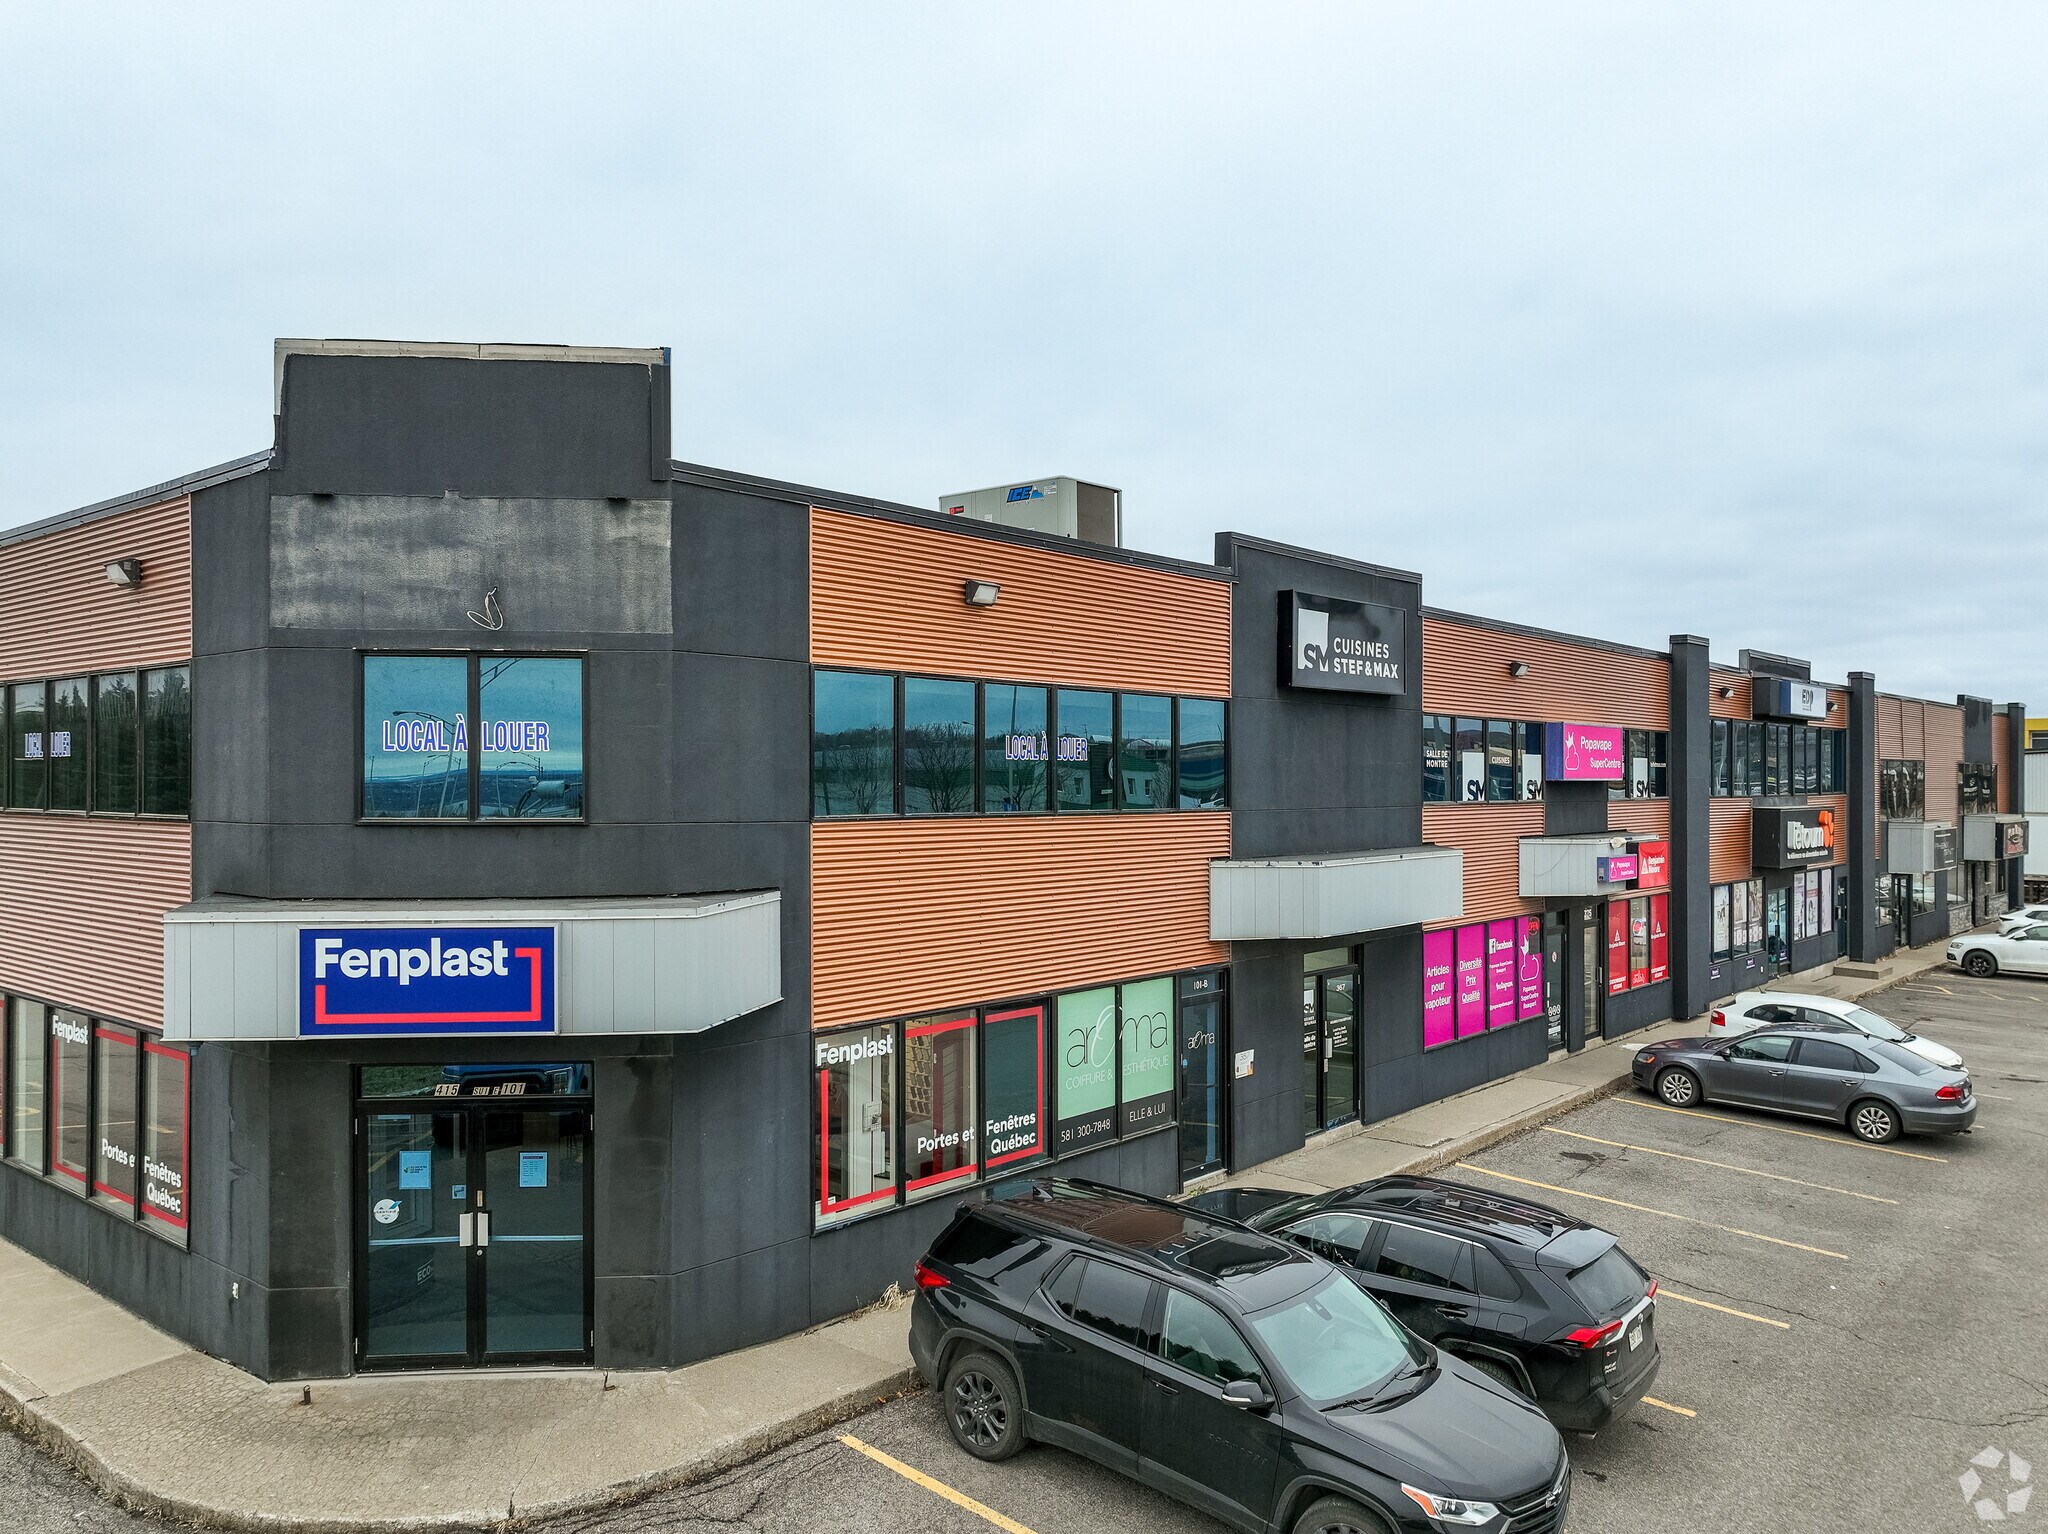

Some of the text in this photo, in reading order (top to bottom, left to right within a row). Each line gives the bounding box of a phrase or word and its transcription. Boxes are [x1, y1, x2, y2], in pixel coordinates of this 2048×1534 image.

[1334, 637, 1390, 659] CUISINES
[1334, 658, 1399, 679] STEF&MAX
[383, 714, 549, 751] LOCAL À LOUER
[1005, 731, 1088, 761] LOCAL À LOUER
[1426, 750, 1448, 758] SALLE DE
[1580, 736, 1612, 753] Popavape
[1426, 760, 1448, 768] MONTRE
[1491, 756, 1510, 764] CUISINES
[1589, 757, 1621, 770] SuperCentre
[315, 938, 508, 985] Fenplast
[1426, 965, 1449, 978] Articles
[1459, 957, 1482, 971] Diversité
[1431, 982, 1445, 995] pour
[1465, 975, 1476, 986] Prix
[1425, 996, 1451, 1011] vapoteur
[1461, 990, 1480, 1003] Qualité
[52, 1015, 88, 1045] Fenplast
[815, 1034, 893, 1066] Fenplast
[1123, 1054, 1169, 1076] ESTHÉTIQUE
[436, 1084, 458, 1096] 415
[502, 1082, 525, 1095] 101
[1066, 1068, 1113, 1090] COIFFURE &
[985, 1111, 1036, 1136] Fenêtres
[1129, 1103, 1166, 1122] ELLE & LUI
[917, 1127, 975, 1154] Portes et
[1061, 1119, 1111, 1142] 581 300-7848
[102, 1138, 128, 1163] Portes
[990, 1132, 1036, 1154] Québec
[144, 1155, 181, 1188] Fenêtres
[147, 1181, 181, 1213] Québec
